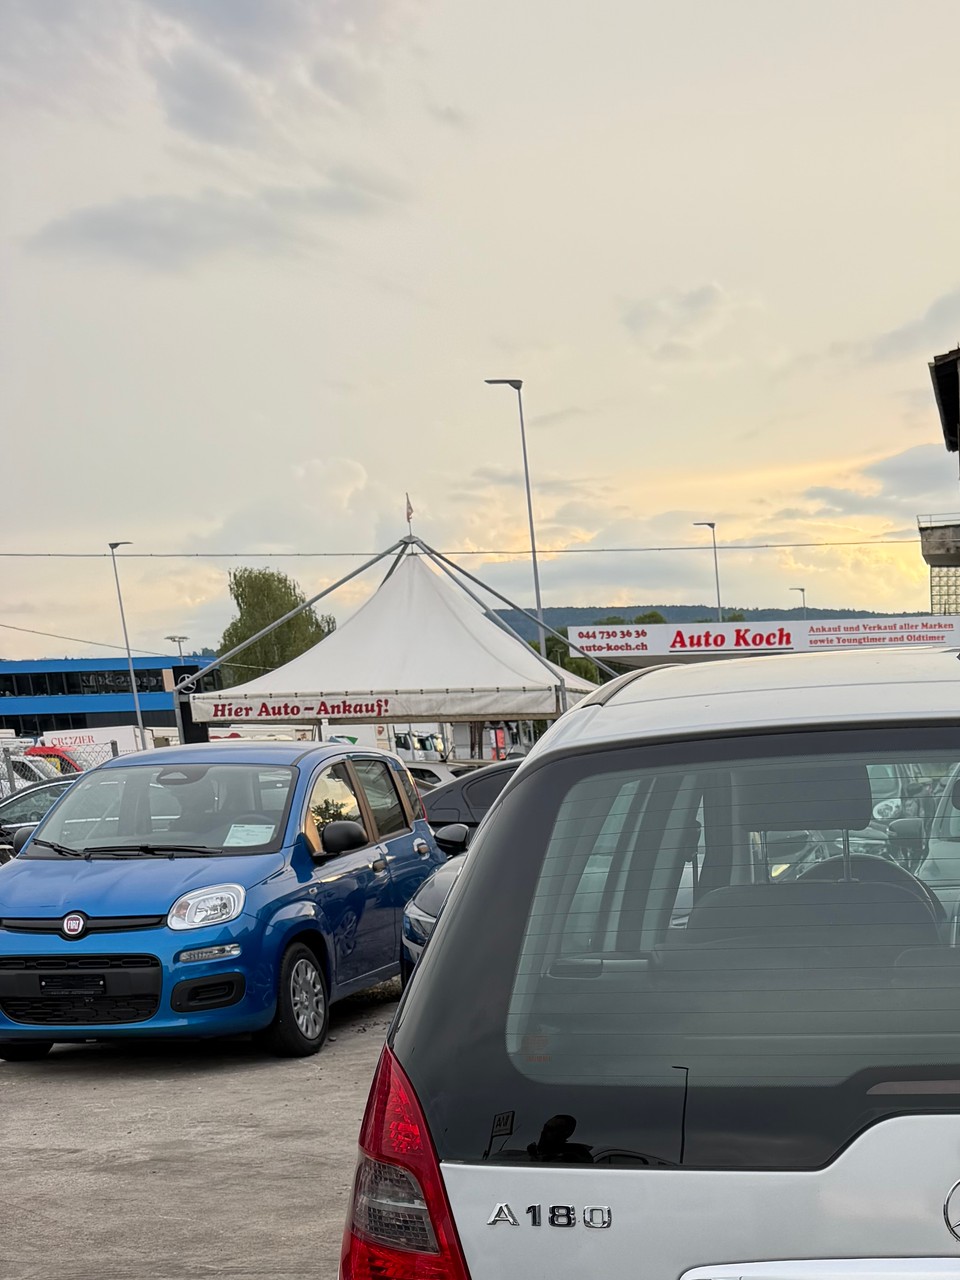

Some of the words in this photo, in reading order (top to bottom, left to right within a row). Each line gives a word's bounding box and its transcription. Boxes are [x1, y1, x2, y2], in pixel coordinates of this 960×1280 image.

[808, 625, 841, 633] Ankauf
[843, 624, 860, 632] und
[862, 623, 897, 631] Verkauf
[921, 622, 954, 630] Marken
[578, 631, 597, 639] 044
[599, 630, 617, 639] 730
[620, 629, 632, 639] 36
[634, 629, 647, 638] 36
[670, 630, 726, 648] Auto
[734, 627, 792, 647] Koch
[809, 637, 834, 645] sowie
[836, 635, 887, 645] Youngtimer
[212, 703, 252, 717] Hier
[67, 920, 80, 929] FIAT
